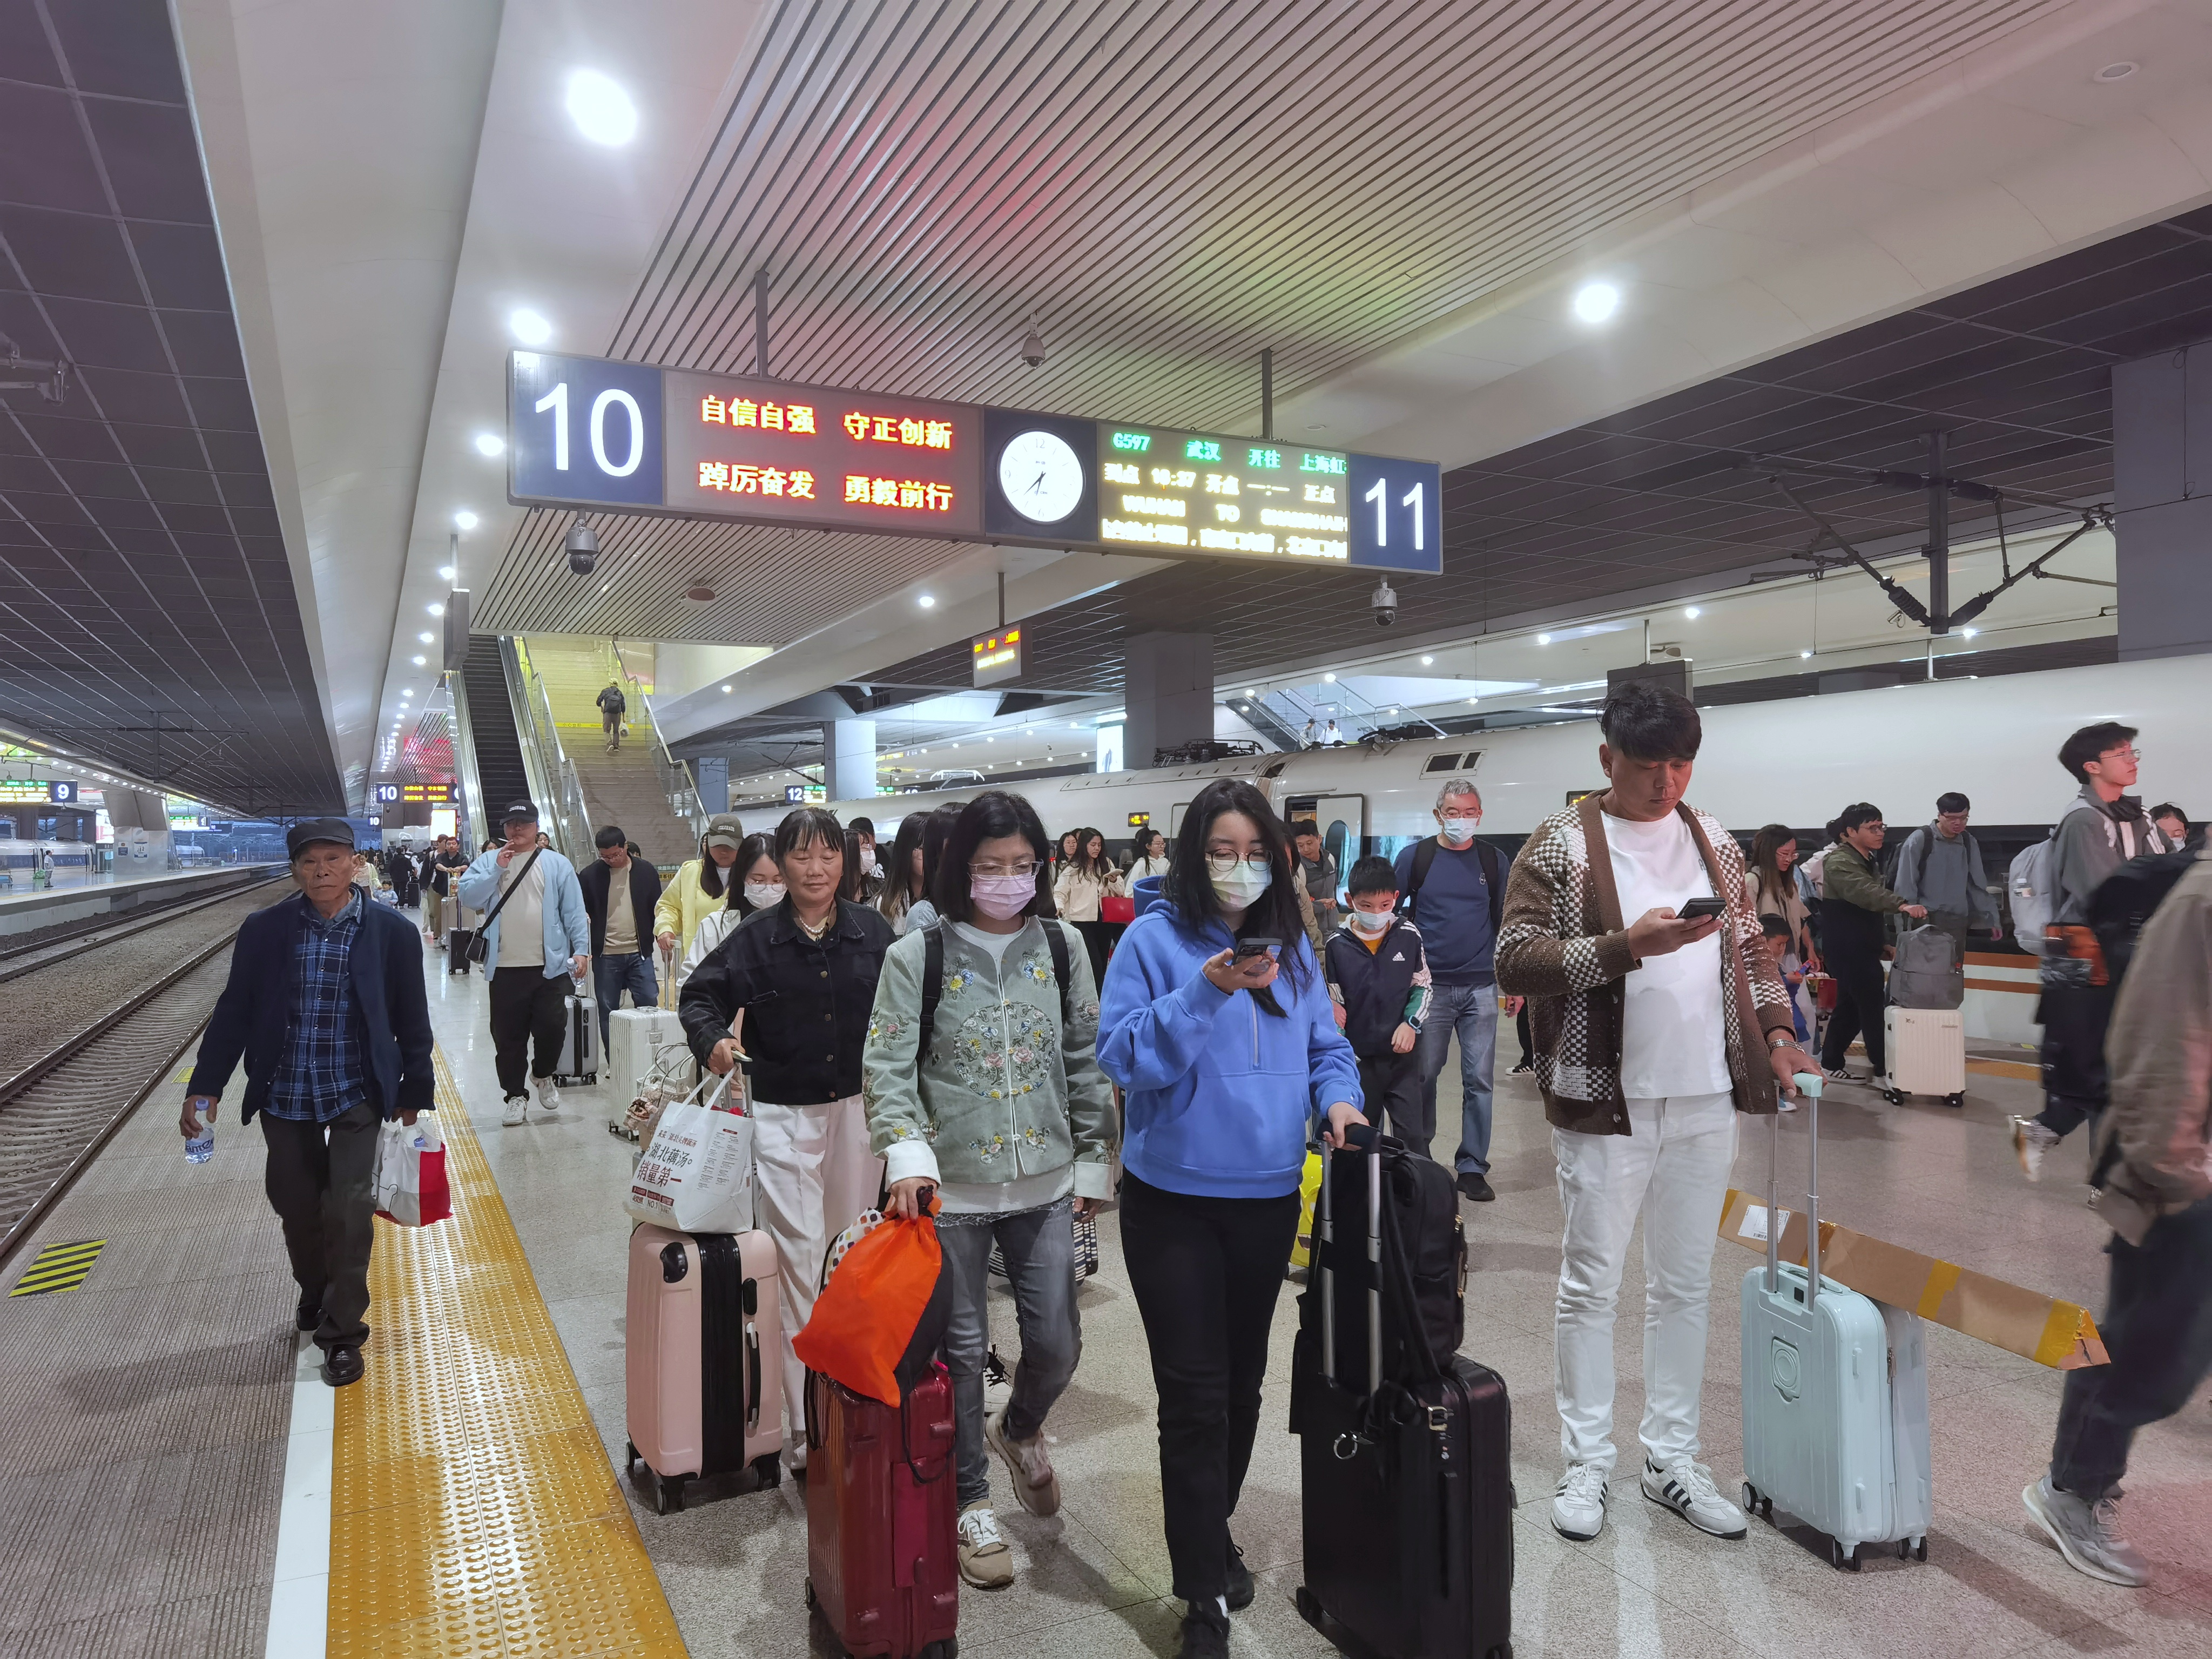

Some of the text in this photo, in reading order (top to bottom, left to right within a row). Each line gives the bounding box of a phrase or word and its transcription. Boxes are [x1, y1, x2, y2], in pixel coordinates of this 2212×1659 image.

[535, 382, 644, 477] 10
[702, 395, 953, 449] 自信自强 守正创新
[1113, 433, 1347, 474] G597 武汉 开往 上海虹
[699, 462, 953, 511] 踔厉奋发 勇毅前行
[1304, 484, 1336, 504] 正点
[1216, 503, 1240, 522] TO
[1365, 477, 1424, 551] 11
[58, 784, 69, 799] 9
[379, 786, 397, 800] 10
[788, 787, 802, 800] 12
[370, 817, 380, 825] 10
[637, 1159, 682, 1188] 销量第一
